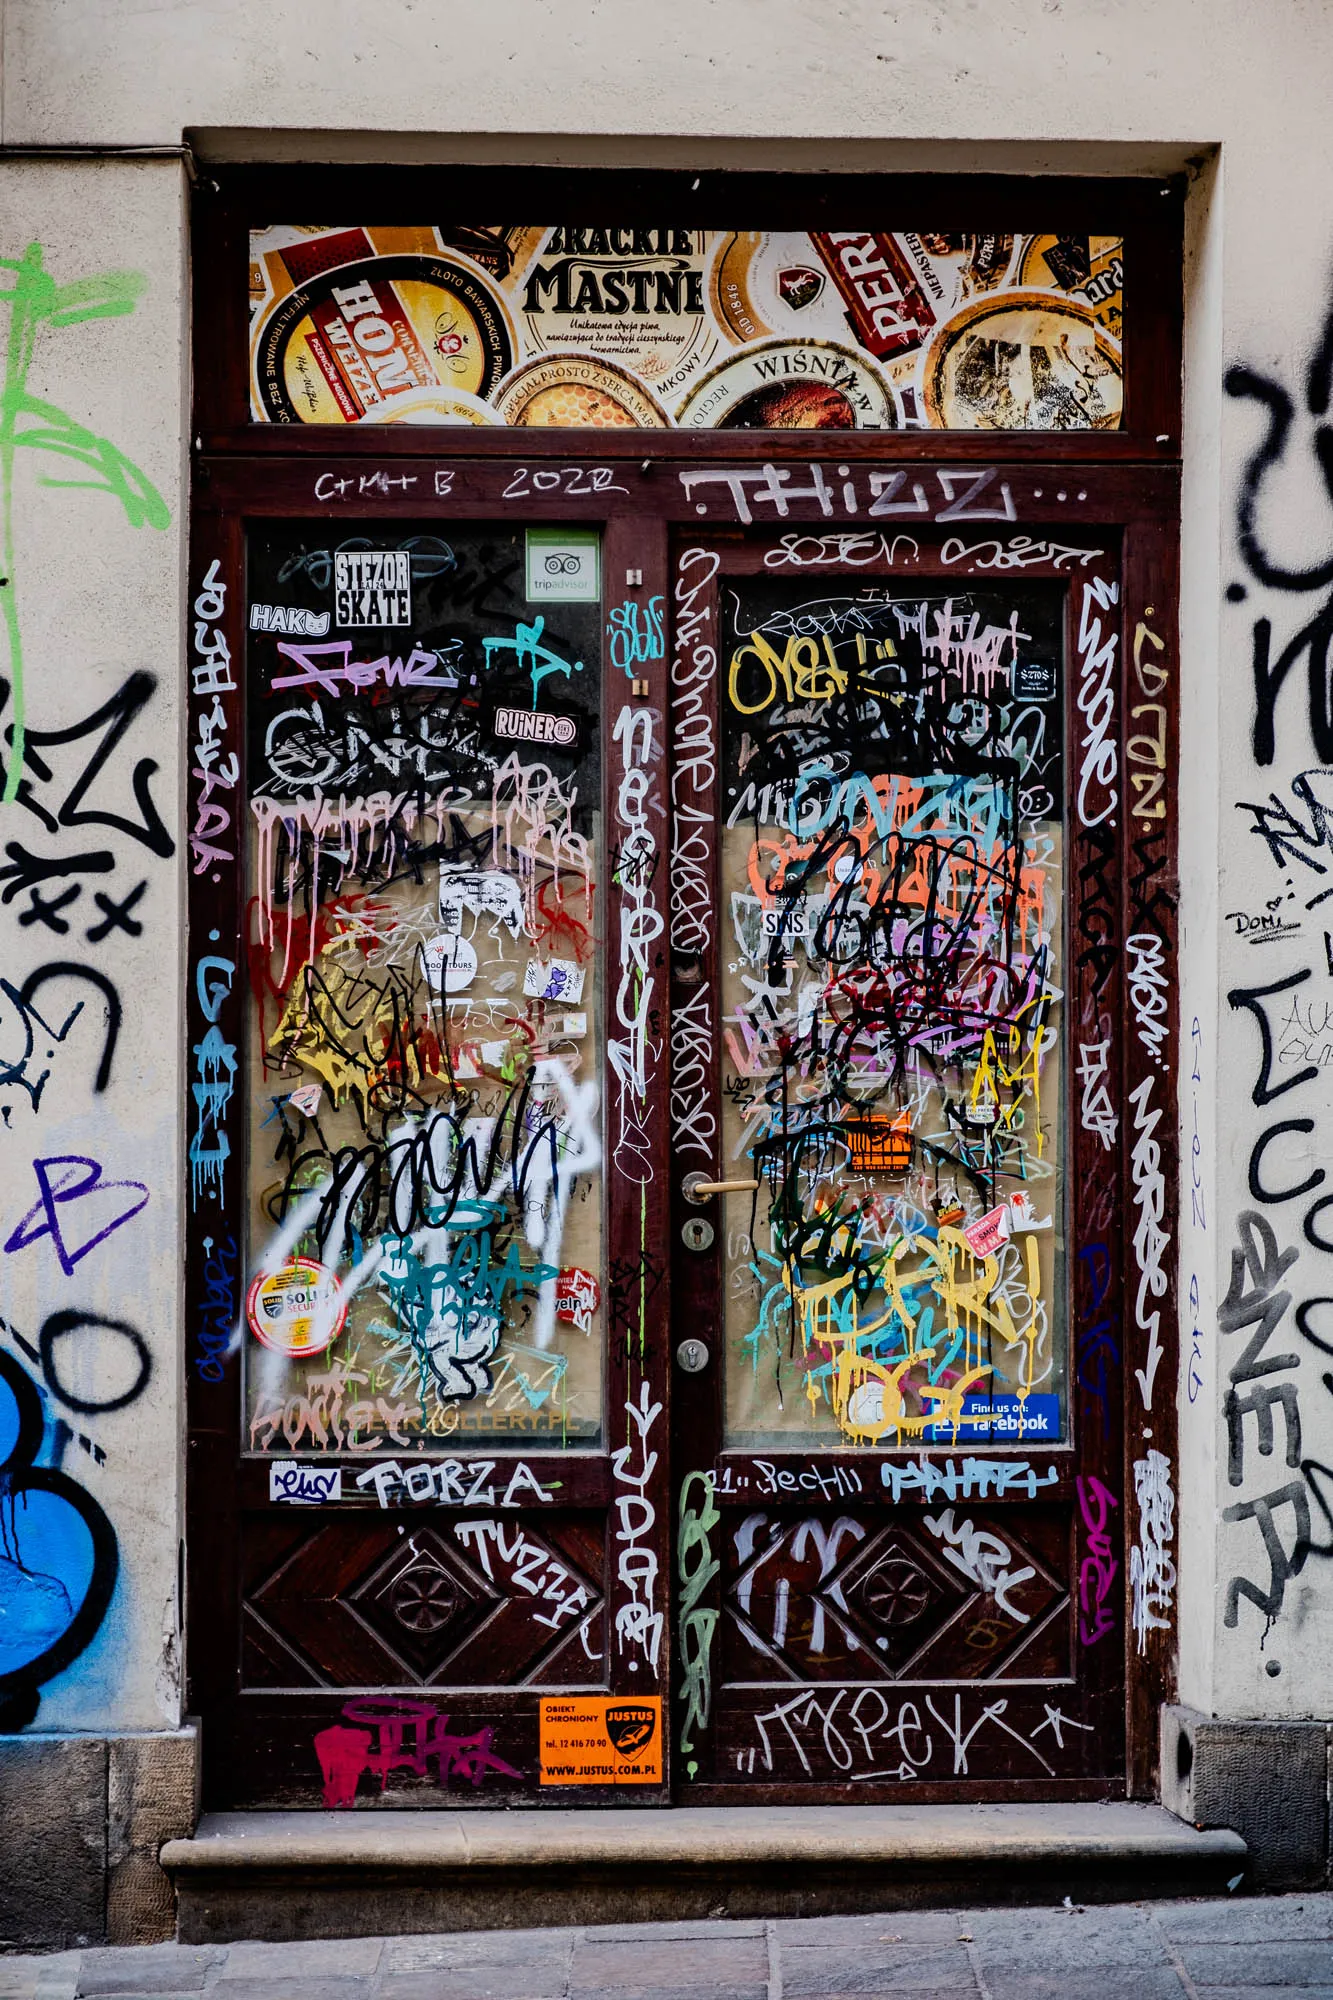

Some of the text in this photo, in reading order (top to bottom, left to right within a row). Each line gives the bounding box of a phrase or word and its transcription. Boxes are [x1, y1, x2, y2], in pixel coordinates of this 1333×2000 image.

[522, 259, 705, 316] MASTNE
[430, 266, 463, 287] ZŁOTO
[463, 286, 501, 350] BAWARSKICH
[727, 284, 742, 315] 1846
[266, 293, 310, 377] NIEFILTROWANE
[268, 382, 282, 405] BEZ
[541, 367, 590, 381] PROSTO
[592, 371, 601, 380] Z
[601, 376, 634, 404] SERCA
[534, 577, 589, 591] tripadvisor
[338, 590, 409, 624] SKATE
[554, 1296, 582, 1312] yelp
[971, 1403, 994, 1413] Find
[356, 1459, 552, 1510] FORZA
[545, 1715, 599, 1723] CHRONIONY
[607, 1712, 654, 1722] JUSTUS
[545, 1739, 607, 1748] tel. 12 416 70 90
[546, 1765, 657, 1776] WWW.JUSTUS.COM.PL
